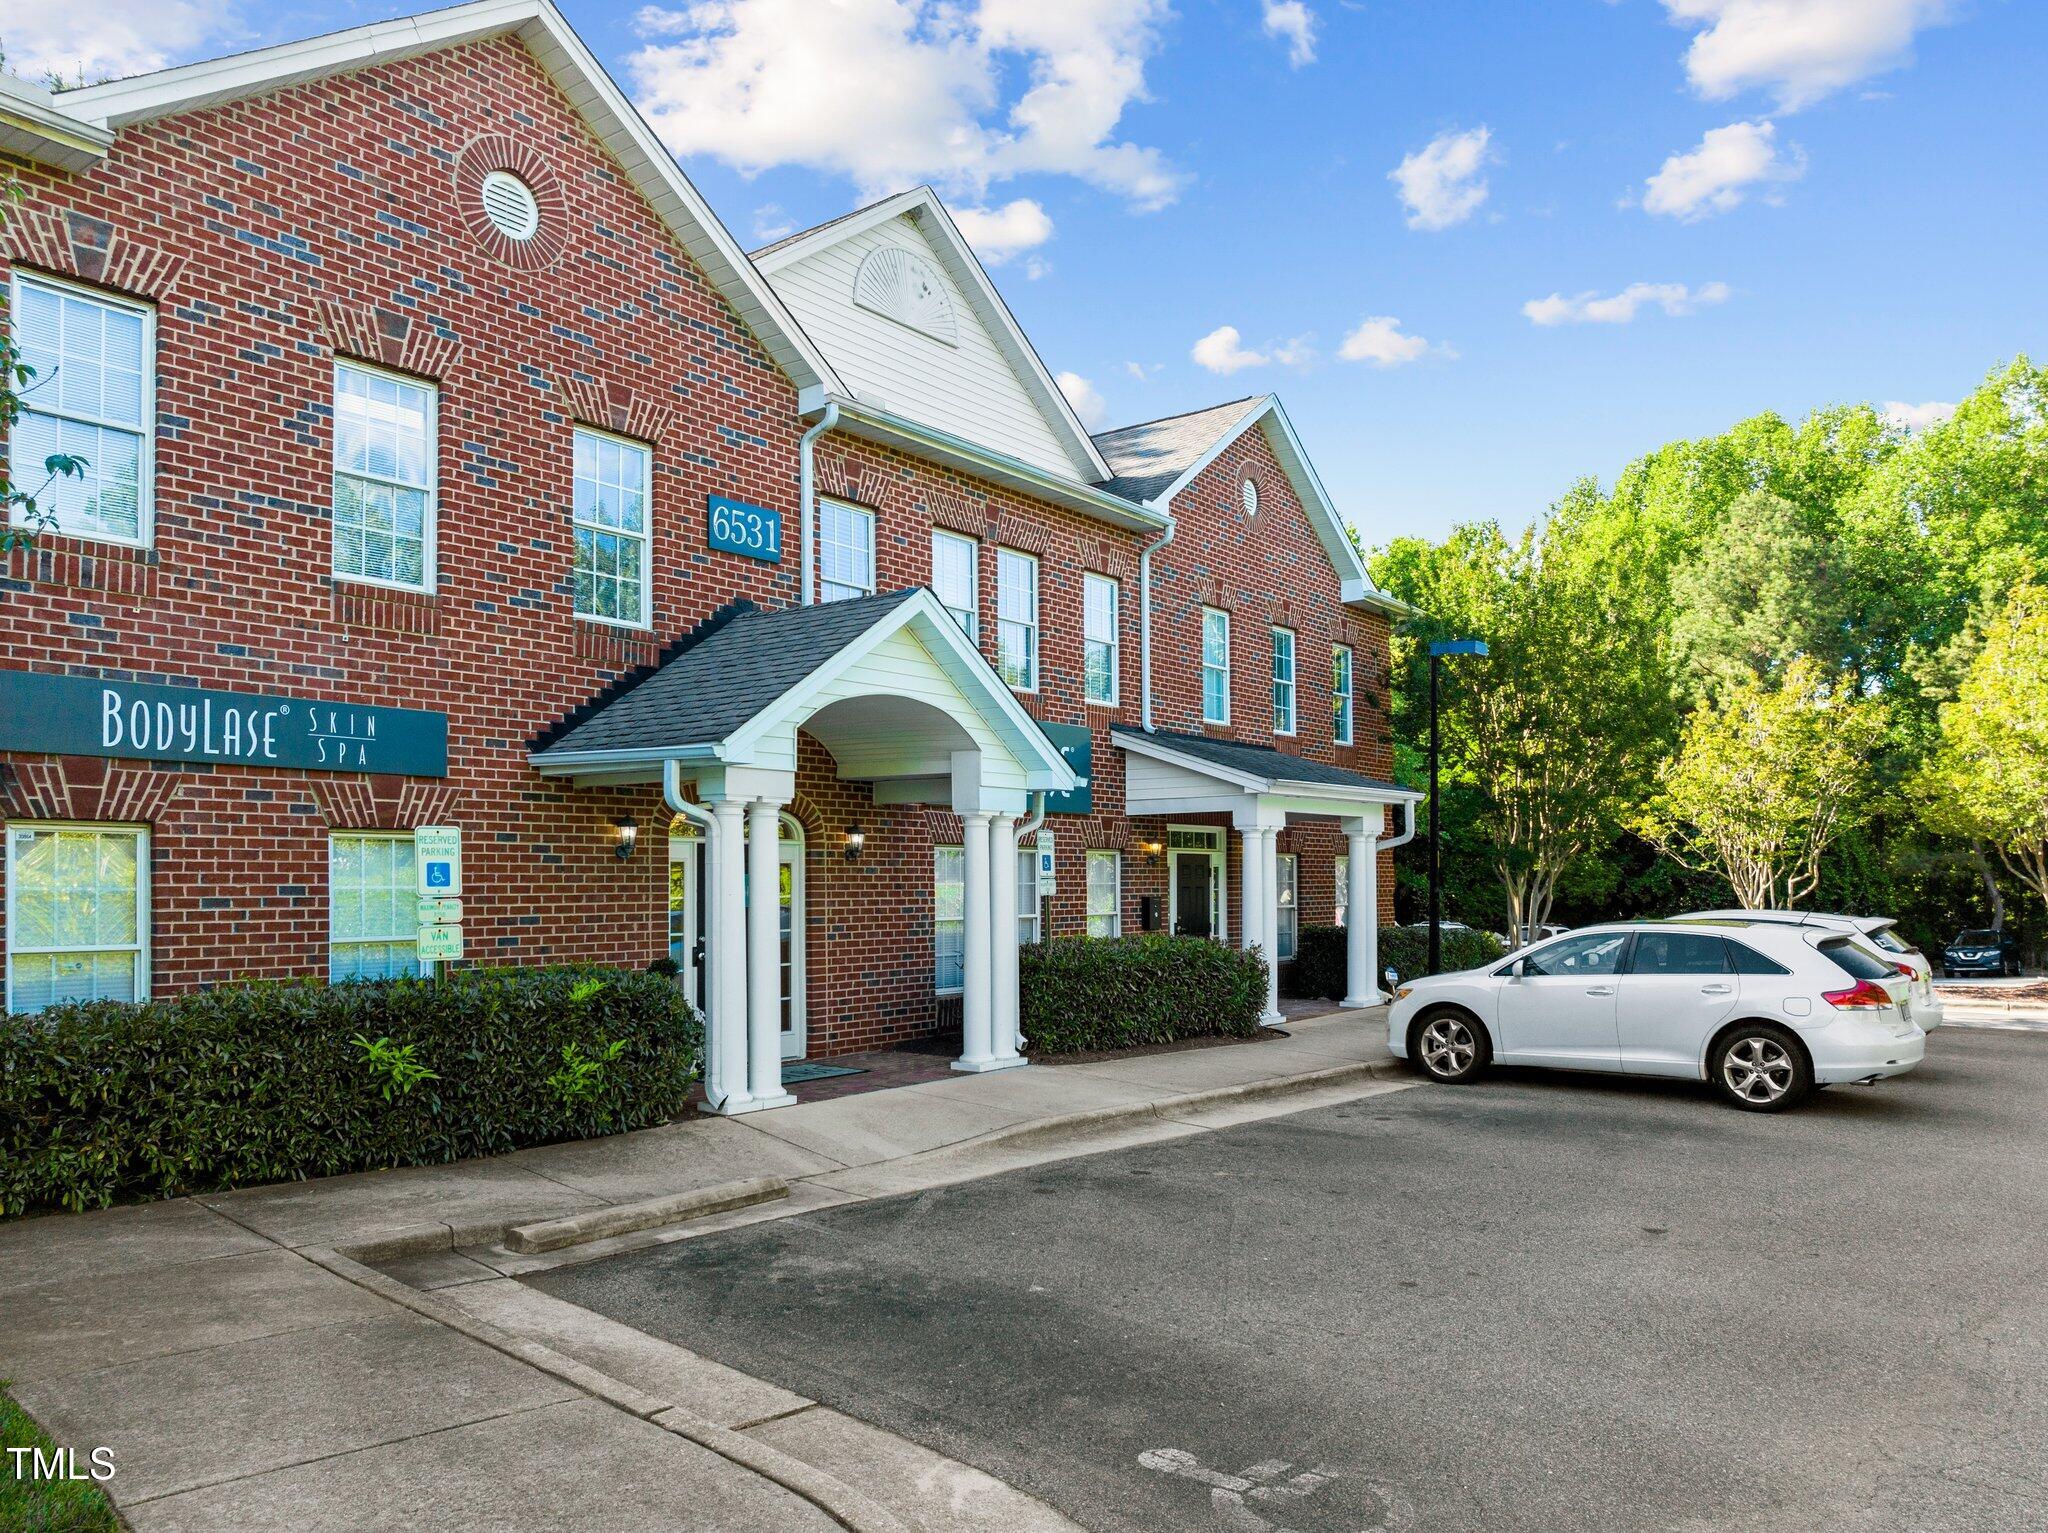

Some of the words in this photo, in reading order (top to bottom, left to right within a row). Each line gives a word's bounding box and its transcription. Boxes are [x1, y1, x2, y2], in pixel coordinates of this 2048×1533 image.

[713, 506, 779, 553] 6531
[308, 707, 376, 737] SKIN
[318, 738, 367, 766] SPA
[418, 835, 457, 845] RESERVED
[421, 847, 456, 857] PARKING
[430, 931, 449, 941] VAN
[421, 944, 460, 955] ACCESSIBLE
